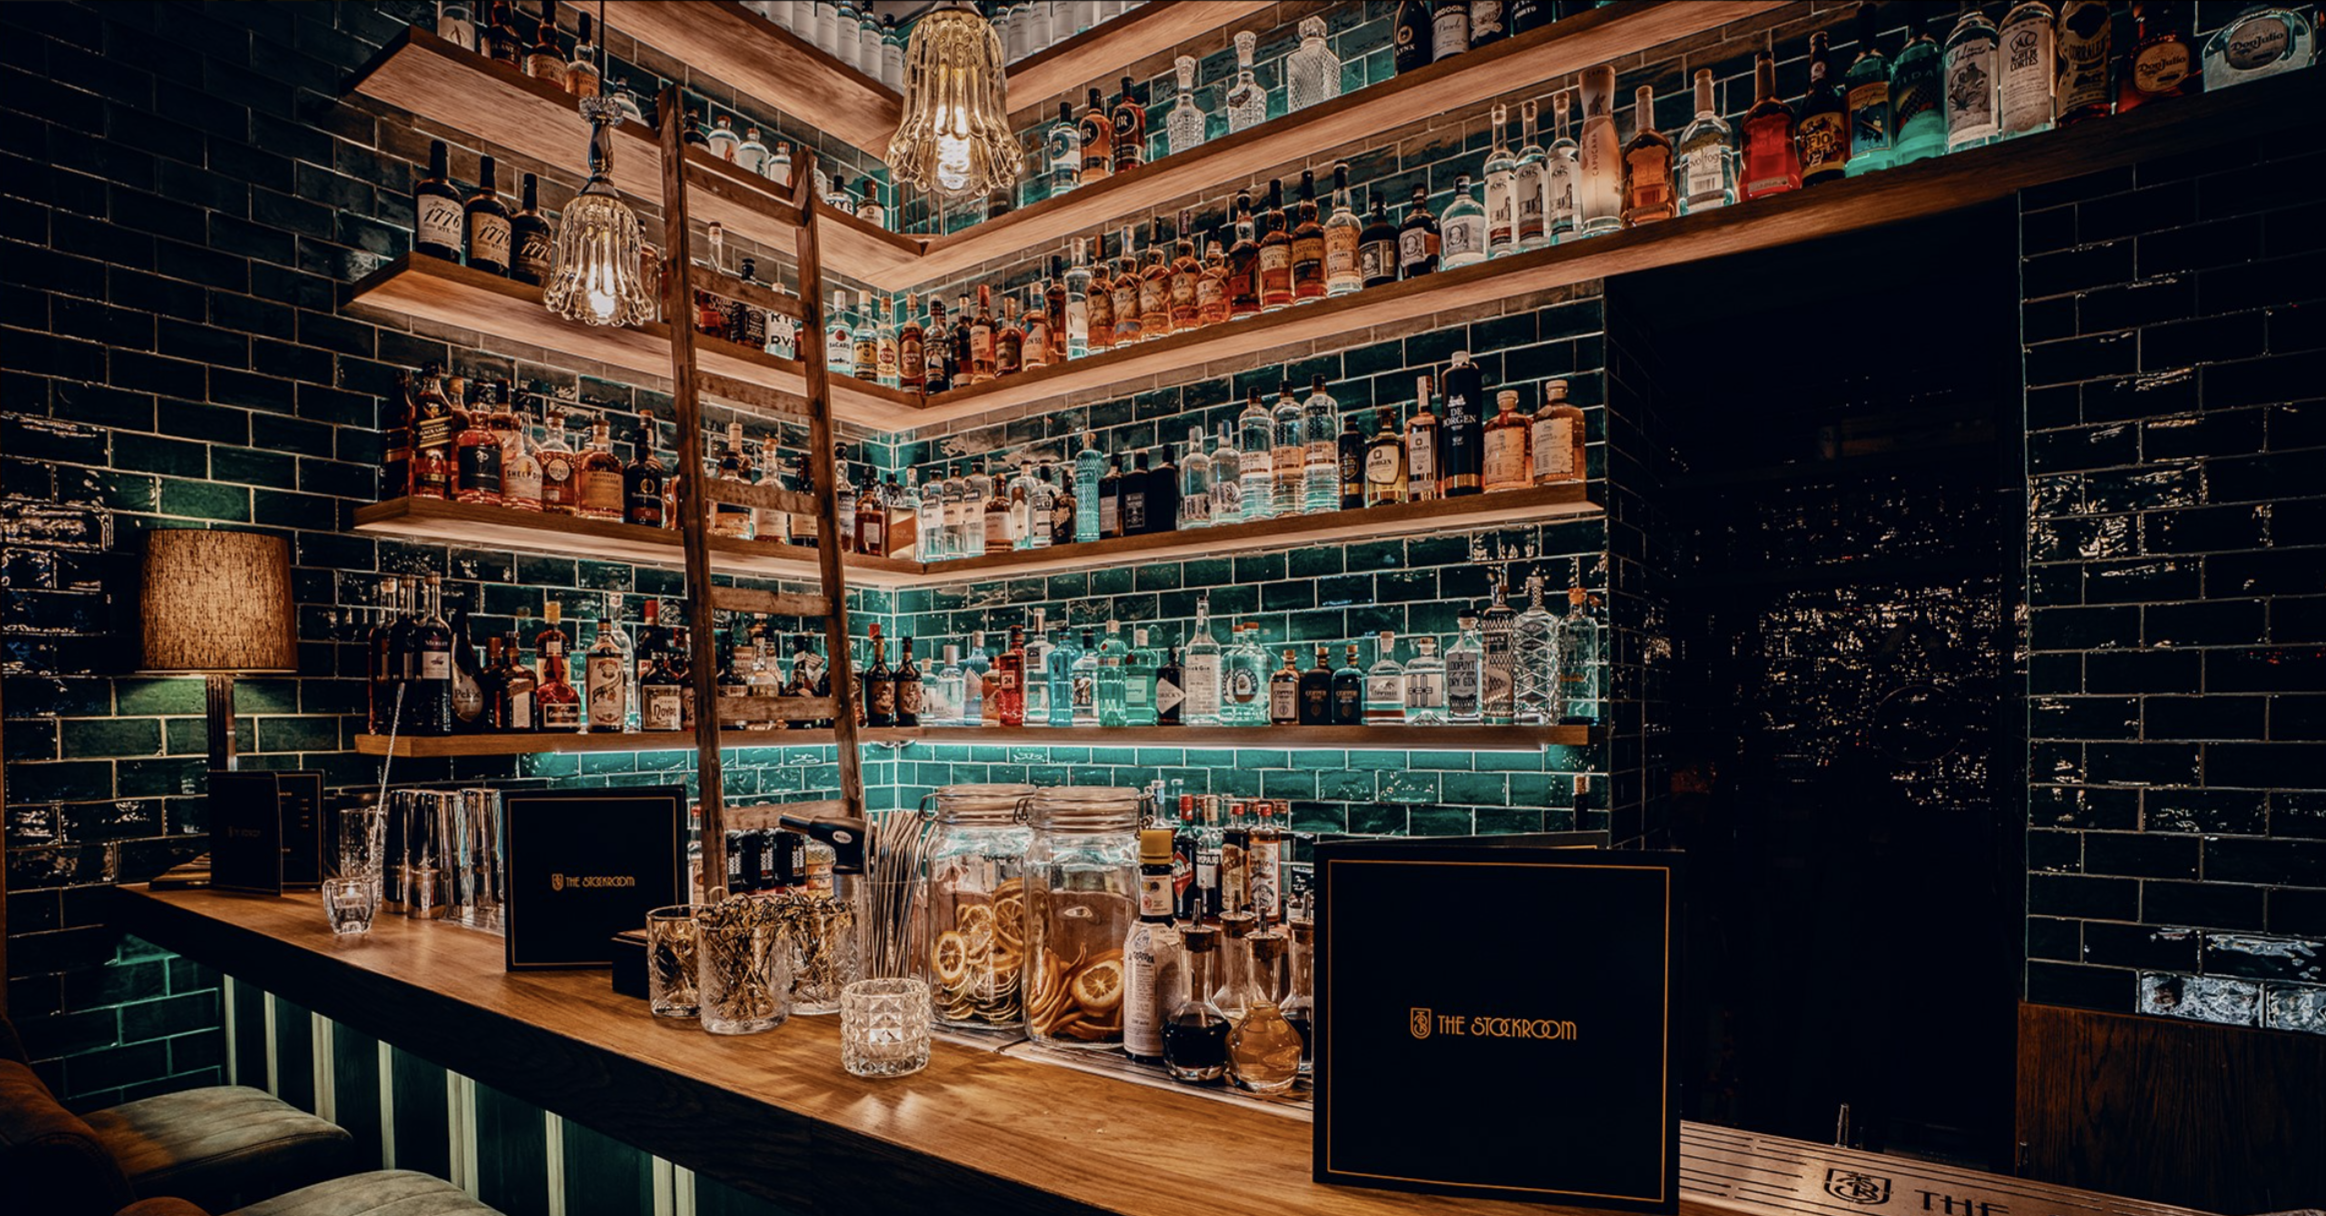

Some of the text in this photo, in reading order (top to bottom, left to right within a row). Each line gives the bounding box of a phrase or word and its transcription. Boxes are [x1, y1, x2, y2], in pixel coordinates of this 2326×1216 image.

[423, 207, 461, 229] 1776
[1451, 407, 1463, 416] DE
[507, 470, 529, 478] SHEEP
[1003, 676, 1013, 685] 24
[1197, 855, 1219, 864] MPARI
[565, 876, 636, 888] THE STOCKROOM
[1437, 1014, 1577, 1041] THE STOCKROOM
